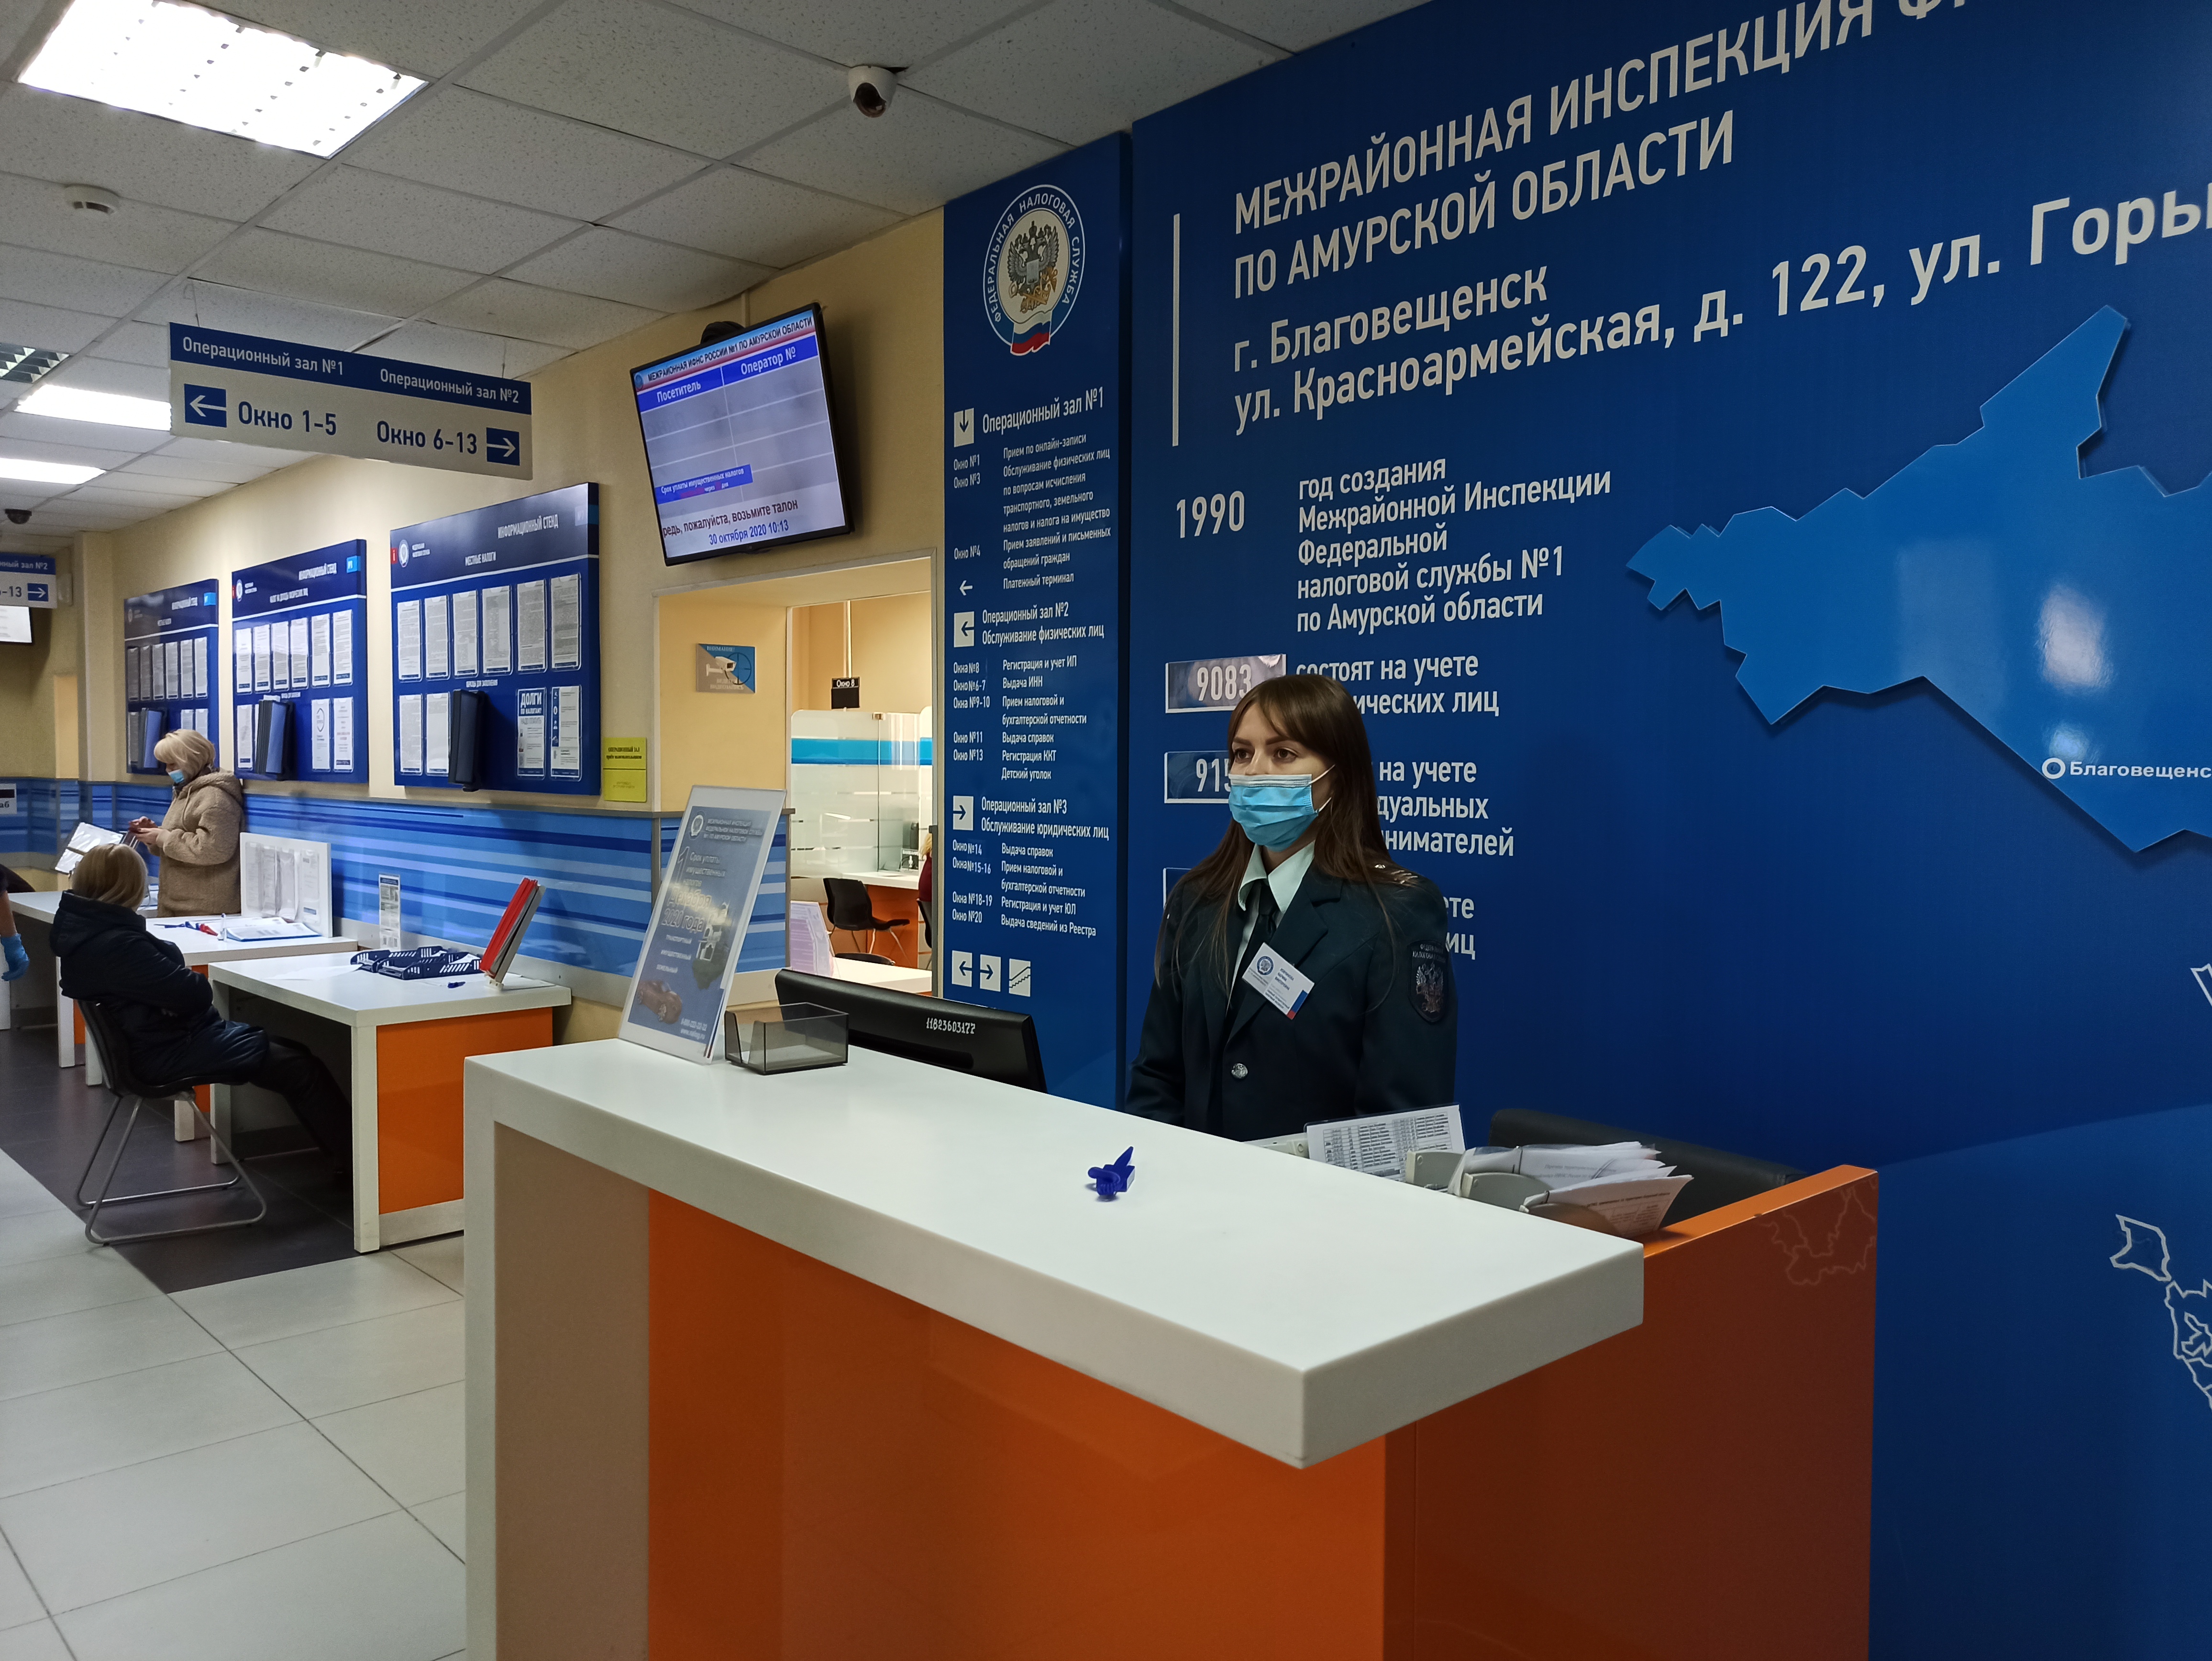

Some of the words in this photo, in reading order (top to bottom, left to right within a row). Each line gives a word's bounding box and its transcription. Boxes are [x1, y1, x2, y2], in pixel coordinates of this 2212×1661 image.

[1236, 95, 1531, 234] МЕЖРАЙОННАЯ
[1550, 0, 1872, 135] ИНСПЕКЦИЯ
[1236, 249, 1276, 299] ПО
[1288, 171, 1495, 285] АМУРСКОЙ
[1513, 110, 1733, 220] ОБЛАСТИ
[987, 213, 1015, 322] ФЕДЕРАЛЬНАЯ
[1019, 193, 1075, 229] НАЛОГОВАЯ
[1062, 236, 1080, 304] СЛУЖБА
[1235, 389, 1280, 435] ул.
[1294, 304, 1674, 420] Красноармейская,
[1694, 290, 1743, 342] д.
[1772, 245, 1884, 316] 122,
[1909, 234, 1999, 306] ул.
[2031, 183, 2212, 265] Горь
[1235, 341, 1257, 372] г.
[1272, 266, 1551, 364] Благовещенск
[183, 337, 290, 366] Операционный
[295, 358, 317, 371] зал
[322, 359, 342, 375] №1
[741, 354, 783, 375] Оператор
[785, 347, 796, 360] №
[381, 369, 472, 396] Операционный
[477, 388, 496, 399] зал
[500, 388, 518, 403] №2
[657, 382, 701, 402] Посетитель
[239, 401, 292, 430] Окно
[303, 410, 336, 435] 1-5
[983, 397, 1060, 435] Операционный
[1063, 398, 1082, 416] зал
[1086, 387, 1102, 410] №1
[377, 421, 425, 447] Окно
[433, 429, 476, 454] 6-13
[1004, 447, 1024, 461] Прием
[1026, 445, 1033, 454] по
[1036, 434, 1086, 452] онлайн-записи
[954, 459, 968, 470] Окно
[970, 454, 979, 467] №1
[1004, 461, 1051, 477] Обслуживание
[1053, 452, 1094, 470] физических
[1096, 449, 1110, 459] лиц
[1004, 487, 1011, 495] по
[1013, 481, 1043, 495] вопросам
[1046, 473, 1085, 488] исчисления
[1300, 477, 1333, 501] год
[1340, 459, 1445, 493] создания
[1004, 499, 1051, 516] транспортного,
[1054, 492, 1093, 506] земельного
[1177, 491, 1244, 538] 1990
[1299, 485, 1455, 533] Межрайонной
[1465, 471, 1610, 511] Инспекции
[684, 515, 730, 532] пожалуйста,
[732, 506, 771, 521] возьмите
[772, 500, 798, 513] талон
[1004, 521, 1029, 532] налогов
[1037, 517, 1059, 527] налога
[1062, 515, 1069, 523] на
[1072, 509, 1110, 524] имущество
[709, 534, 717, 545] 30
[719, 529, 748, 543] октября
[749, 524, 766, 537] 2020
[768, 519, 789, 533] 10:13
[1004, 540, 1024, 553] Прием
[1026, 532, 1060, 547] заявлений
[1062, 534, 1066, 543] и
[1069, 528, 1110, 542] письменных
[1299, 522, 1447, 567] Федеральной
[954, 548, 968, 559] Окно
[970, 545, 980, 557] №4
[1004, 554, 1039, 571] обращений
[1041, 553, 1070, 566] граждан
[1004, 575, 1040, 589] Платежный
[1042, 574, 1073, 587] терминал
[1298, 562, 1408, 598] налоговой
[1417, 553, 1511, 592] службы
[1522, 546, 1561, 578] №1
[0, 586, 22, 597] -13
[983, 605, 1037, 626] Операционный
[1040, 607, 1052, 619] зал
[1055, 602, 1068, 617] №2
[1298, 612, 1320, 631] по
[1327, 596, 1435, 635] Амурской
[1444, 594, 1542, 621] области
[983, 630, 1036, 647] Обслуживание
[1039, 626, 1086, 644] физических
[1088, 625, 1104, 638] лиц
[1003, 660, 1042, 672] Регистрация
[1051, 659, 1065, 670] учет
[1067, 655, 1076, 667] ИП
[1381, 660, 1405, 679] на
[1414, 656, 1478, 686] учете
[1003, 677, 1027, 689] Выдача
[1029, 676, 1042, 687] ИНН
[1197, 664, 1251, 700] 9083
[520, 693, 542, 708] ДОЛГИ
[1003, 696, 1022, 709] Прием
[1025, 694, 1058, 706] налоговой
[1353, 691, 1444, 714] ических
[1452, 689, 1499, 717] лиц
[1003, 713, 1048, 727] бухгалтерской
[1050, 715, 1086, 724] отчетности
[1003, 732, 1026, 744] Выдача
[1028, 734, 1053, 745] справок
[1003, 750, 1041, 764] Регистрация
[1044, 750, 1056, 761] ККТ
[1002, 767, 1028, 780] Детский
[1029, 771, 1051, 781] уголок
[1380, 762, 1404, 781] на
[1412, 762, 1476, 788] учете
[2070, 762, 2211, 779] Благовещенс
[982, 797, 1035, 814] Операционный
[1038, 802, 1051, 813] зал
[1054, 799, 1067, 814] №3
[1377, 796, 1489, 823] дуальных
[982, 817, 1035, 835] Обслуживание
[1037, 824, 1091, 838] юридических
[1093, 827, 1109, 841] лиц
[1381, 827, 1513, 856] нимателей
[1002, 896, 1040, 912] Регистрация
[1049, 904, 1063, 915] учет
[1065, 903, 1075, 915] ЮЛ
[1001, 914, 1025, 928] Выдача
[1027, 920, 1057, 931] сведений
[1060, 924, 1067, 932] из
[1070, 922, 1095, 938] Реестра
[1445, 932, 1475, 960] иц
